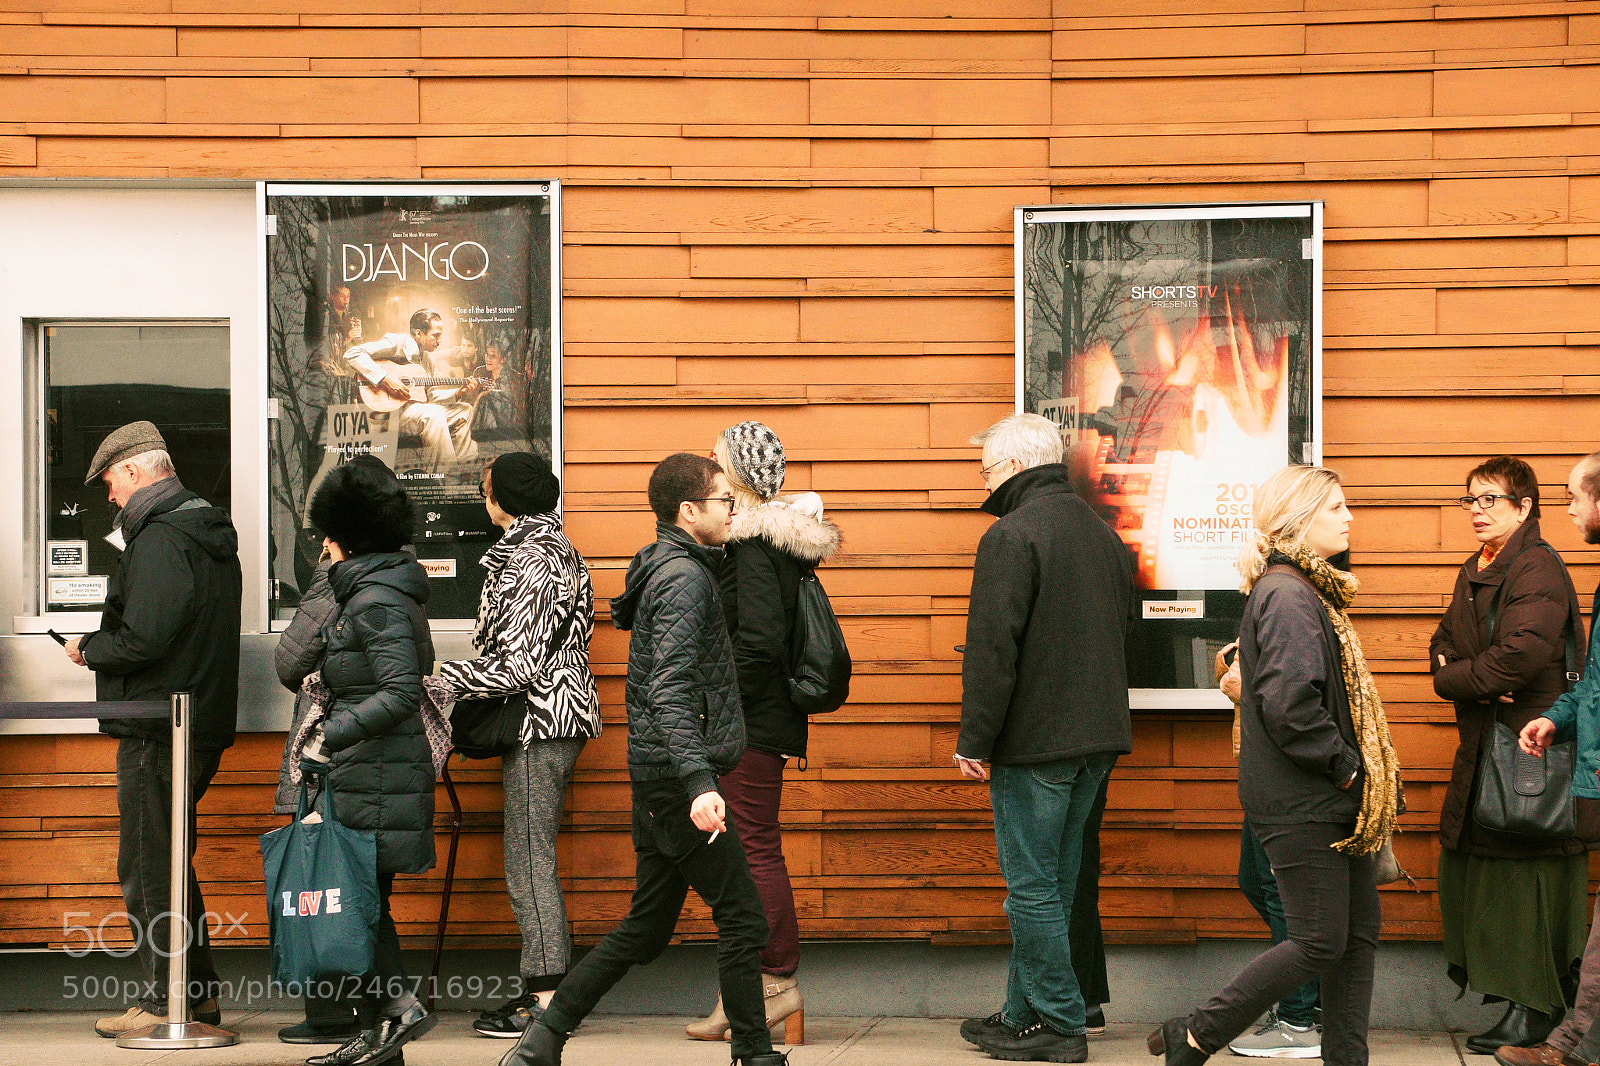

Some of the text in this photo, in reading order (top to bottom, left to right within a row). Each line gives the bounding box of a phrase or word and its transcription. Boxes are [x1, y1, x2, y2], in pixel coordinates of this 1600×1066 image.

[342, 241, 489, 282] DJANGO
[1131, 285, 1218, 299] SHORTSTV
[468, 306, 474, 314] of
[475, 306, 485, 314] the
[485, 305, 497, 314] best
[1215, 483, 1258, 502] 201
[1216, 504, 1251, 515] OSC
[1173, 517, 1255, 529] NOMINAT
[1173, 532, 1256, 543] SHORT FIL
[1168, 606, 1196, 614] Playing
[282, 888, 341, 916] LOVE
